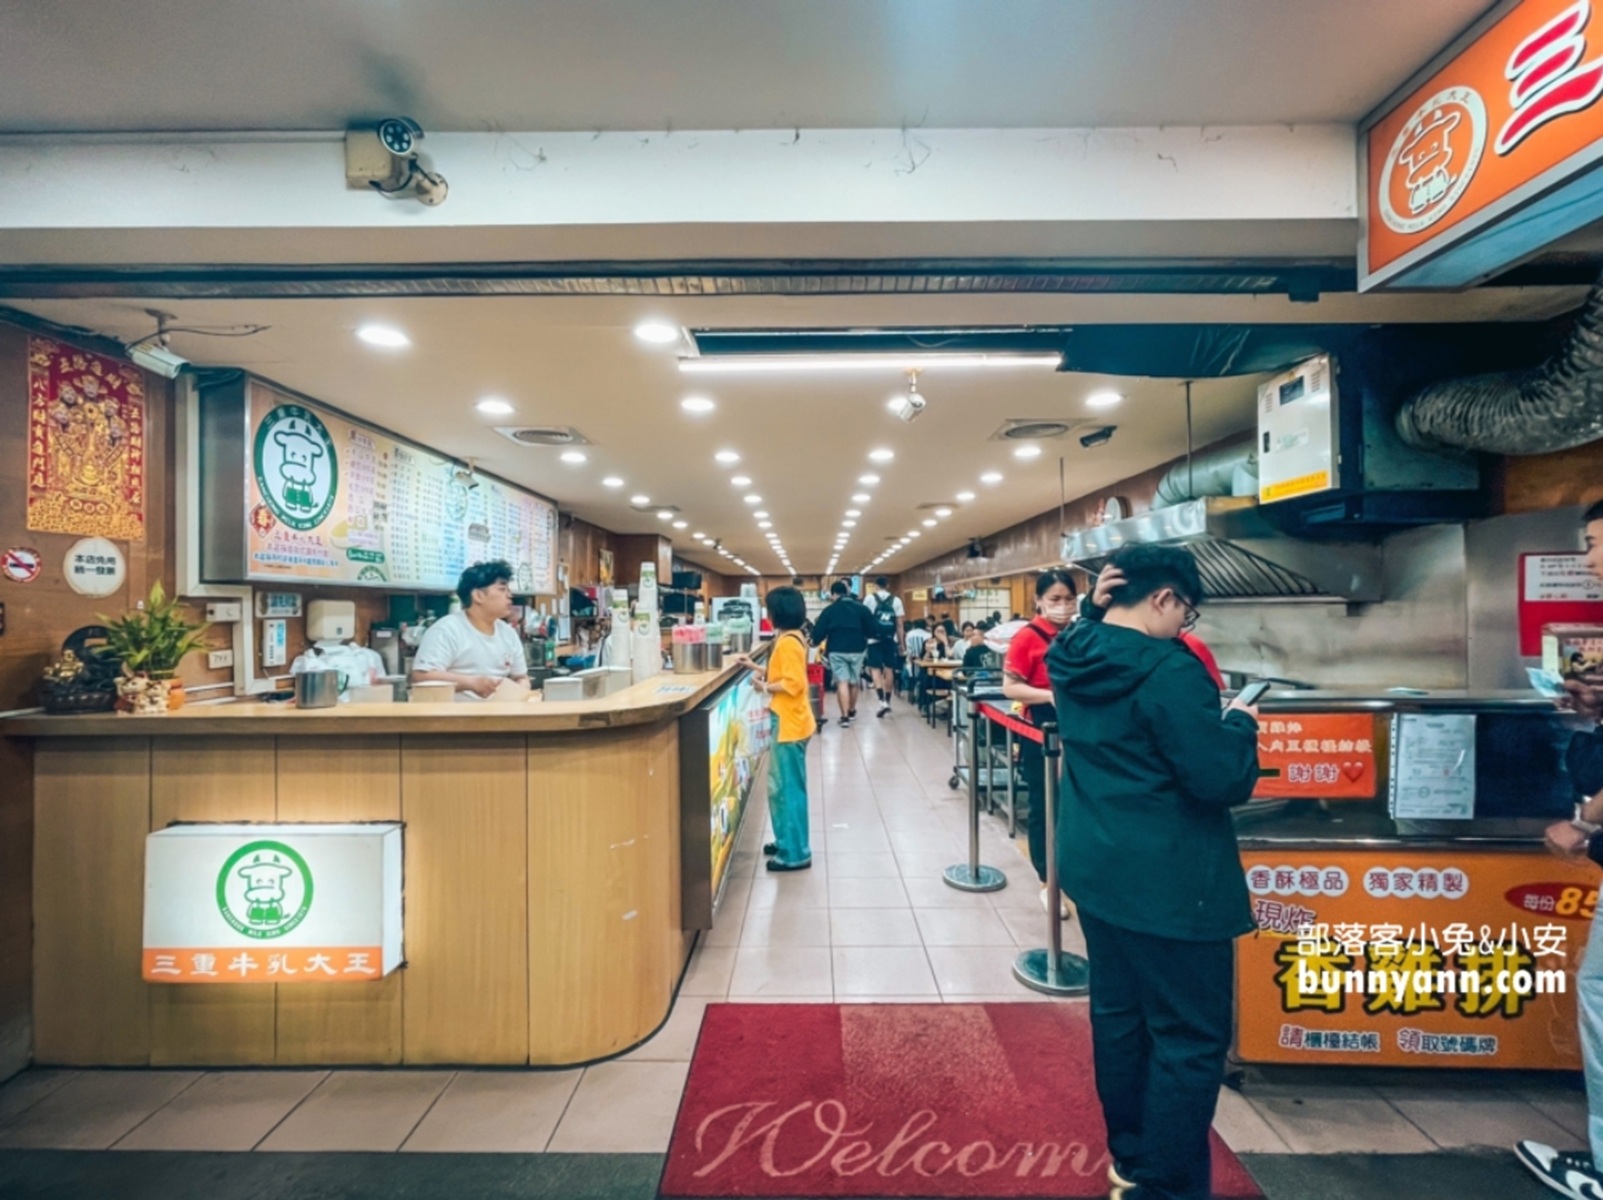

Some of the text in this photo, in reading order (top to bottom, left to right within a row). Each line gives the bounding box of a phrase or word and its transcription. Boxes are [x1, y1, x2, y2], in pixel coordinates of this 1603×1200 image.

[74, 565, 116, 576] 統一發票
[1288, 762, 1341, 784] 謝謝
[1250, 869, 1465, 892] 香酥極品 獨家精製
[1523, 893, 1555, 911] 每份
[151, 952, 377, 977] 三重牛乳大王
[1279, 1024, 1498, 1055] 請櫃檯結帳 領取號碼牌
[694, 1098, 1109, 1178] Welcom
